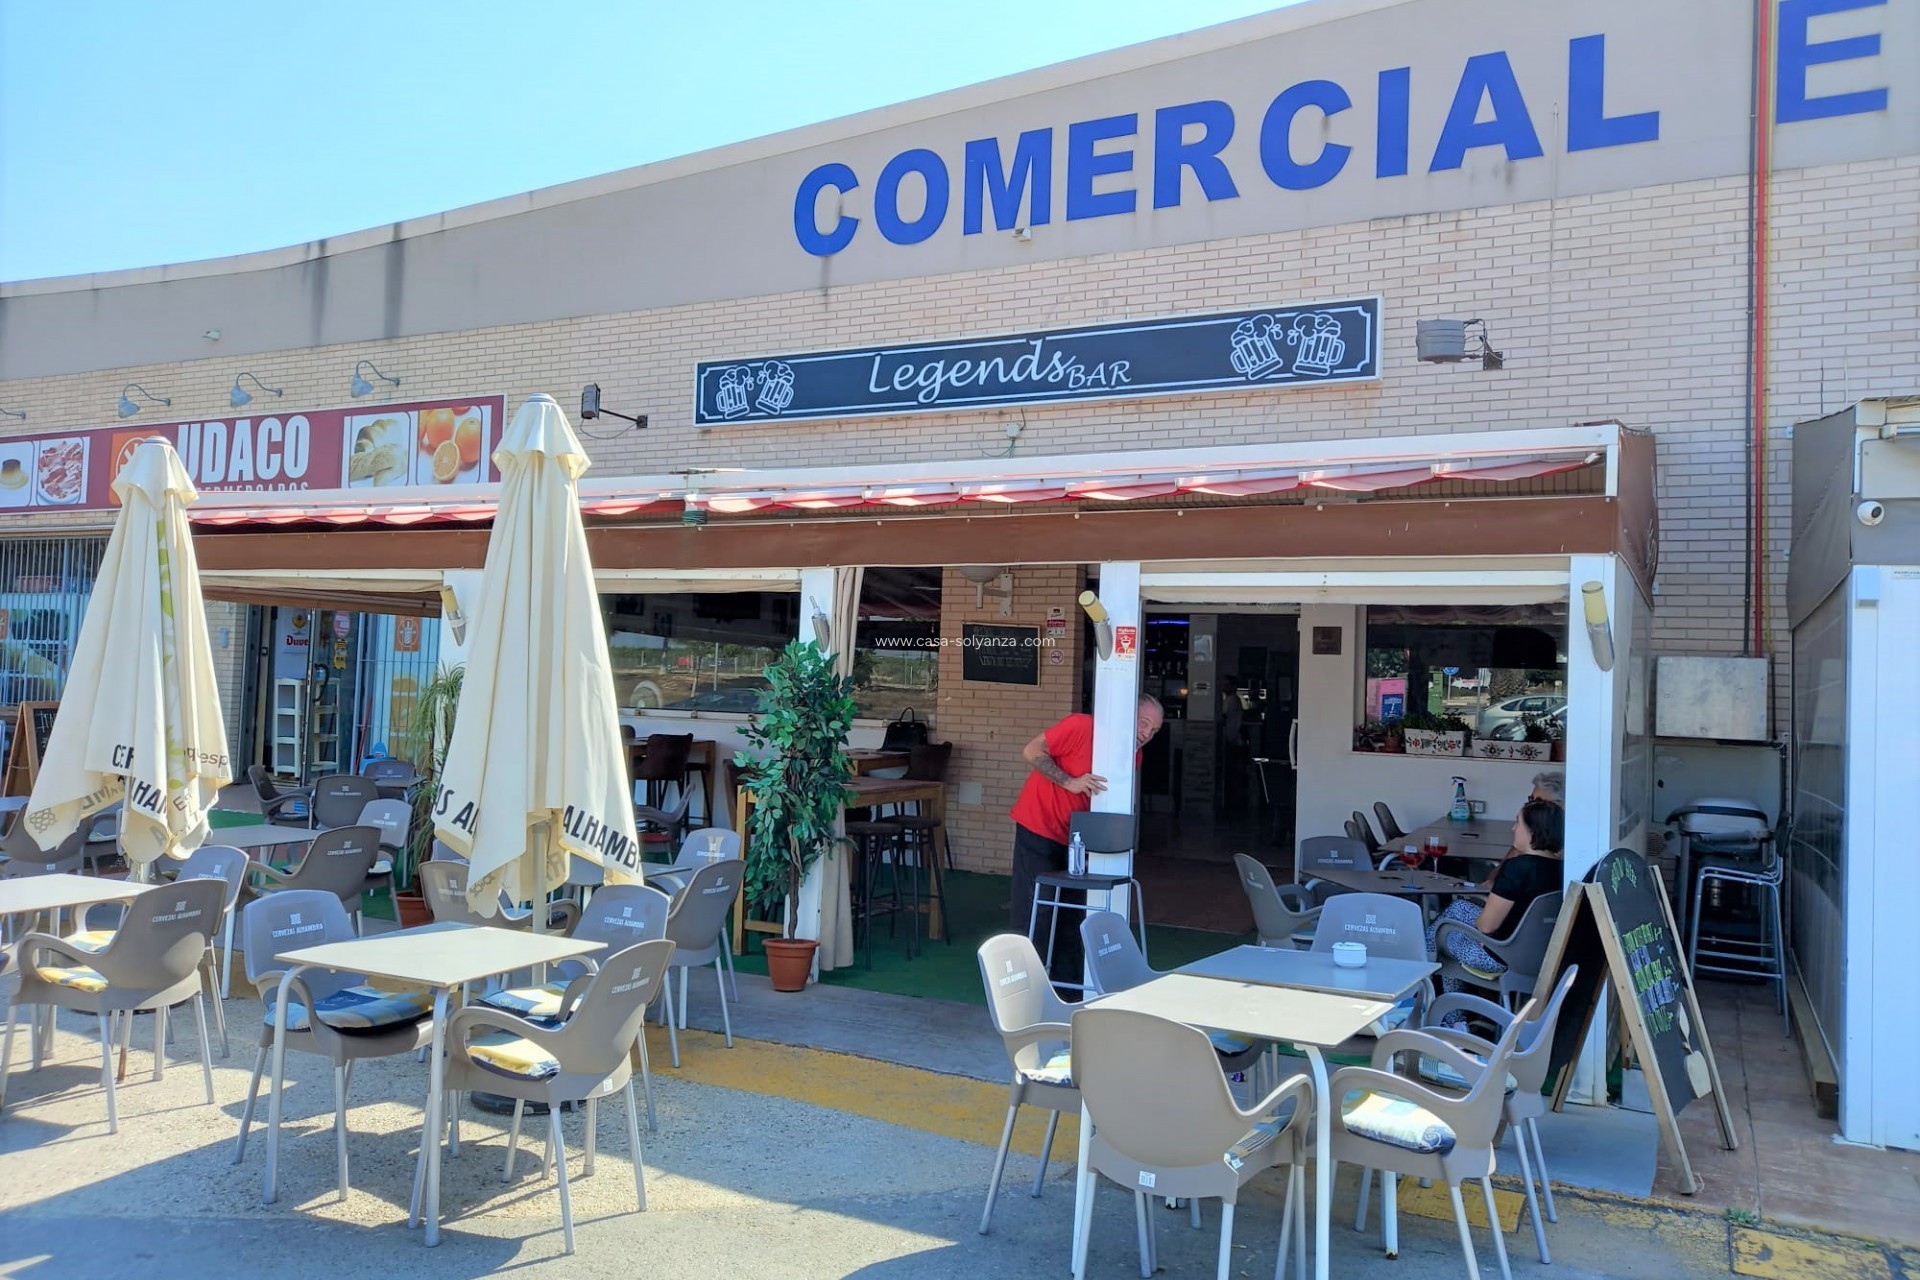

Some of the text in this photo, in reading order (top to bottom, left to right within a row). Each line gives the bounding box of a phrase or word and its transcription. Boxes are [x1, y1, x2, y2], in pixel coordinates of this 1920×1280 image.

[795, 0, 1888, 255] COMERCIAL E
[869, 339, 1131, 403] Legends BAR
[563, 804, 640, 874] ALHAMB
